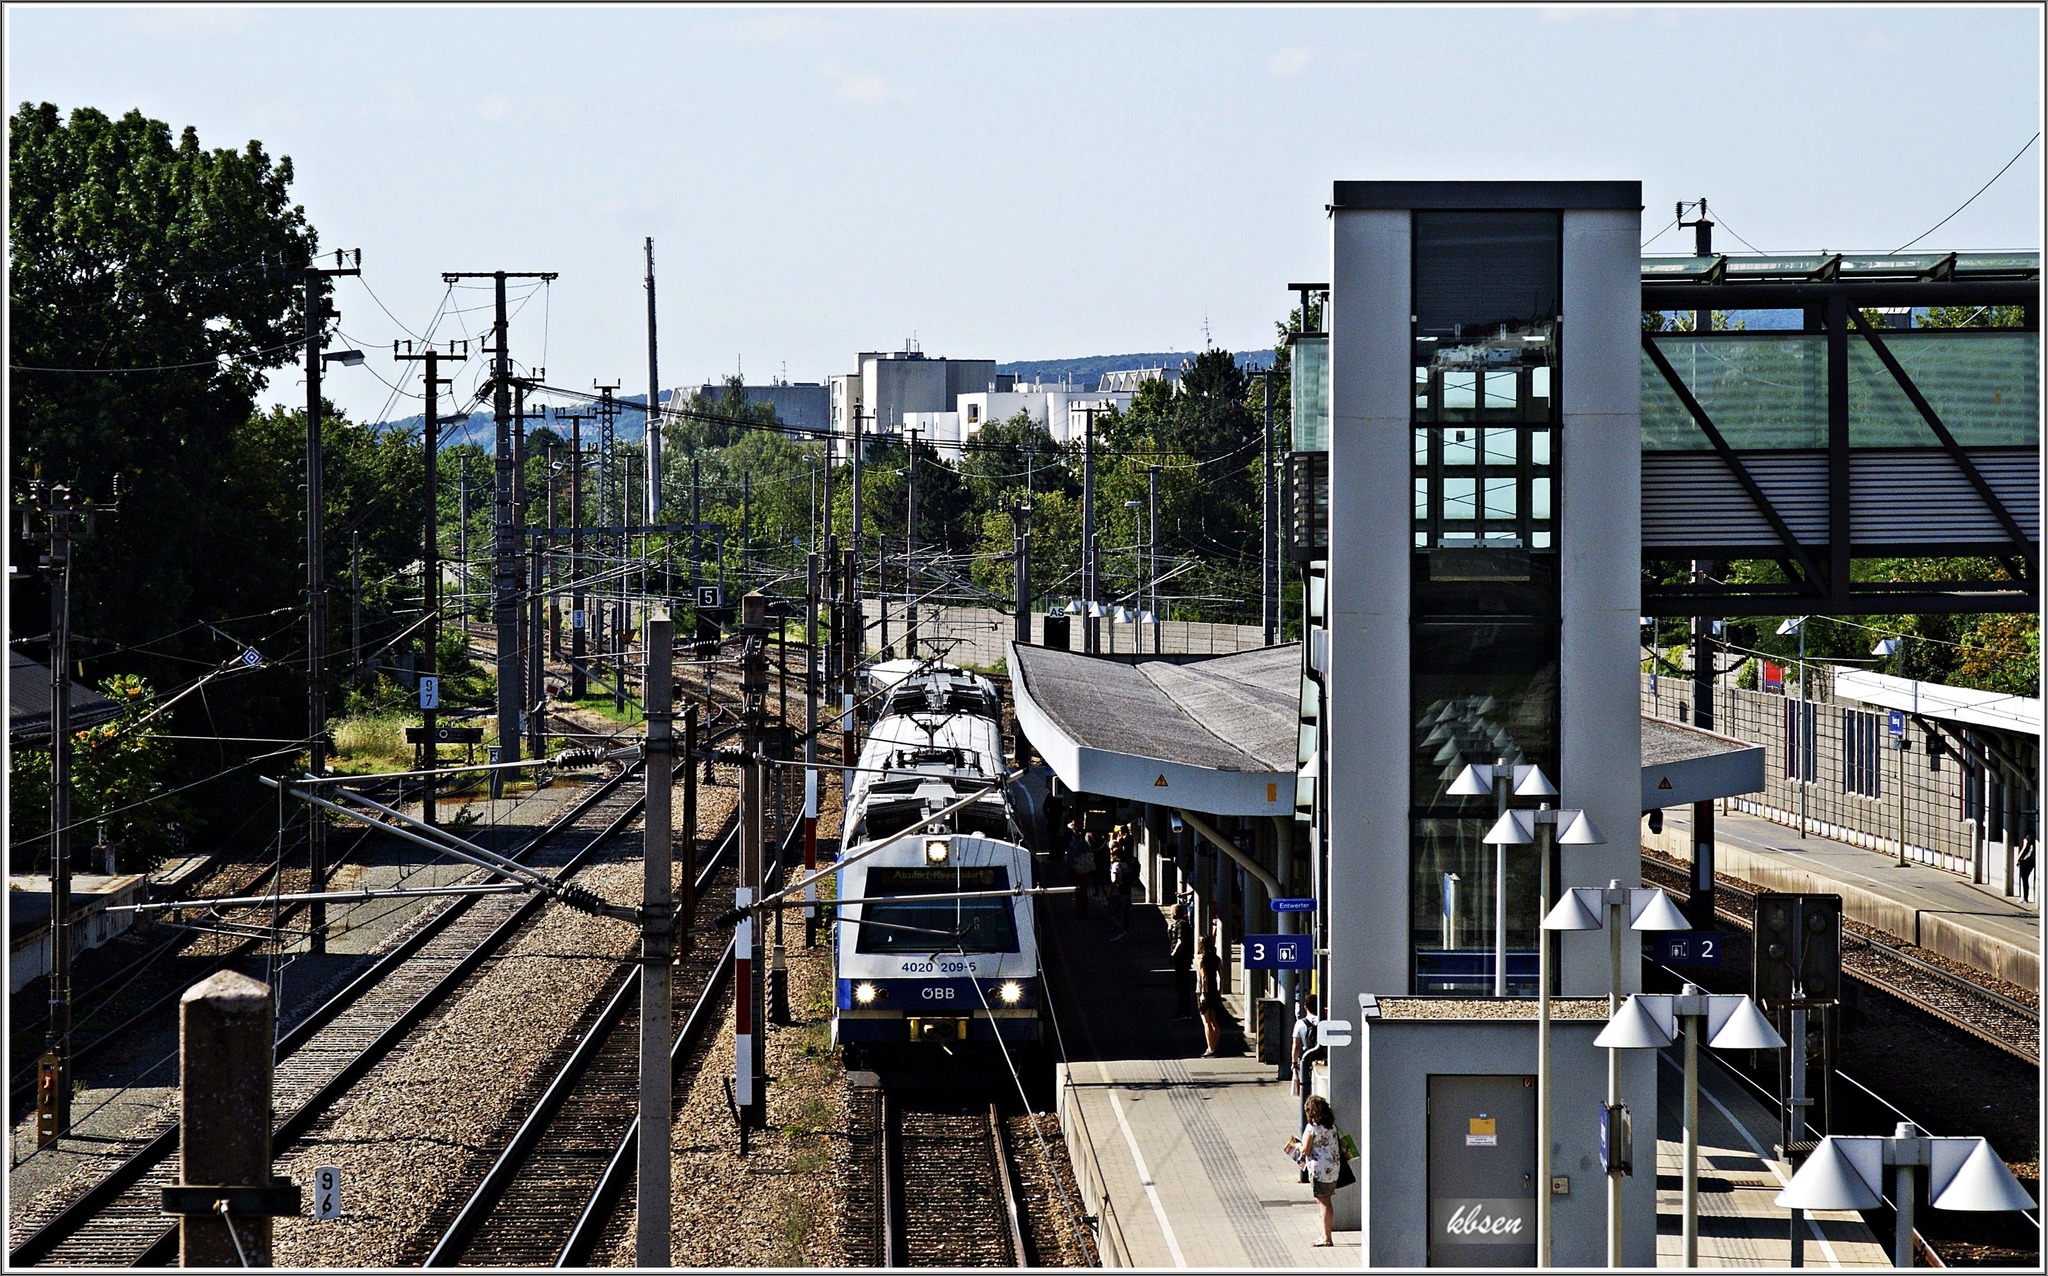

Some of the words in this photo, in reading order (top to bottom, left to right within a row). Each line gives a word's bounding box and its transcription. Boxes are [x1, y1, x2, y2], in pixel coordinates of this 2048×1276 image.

[704, 590, 713, 604] 5
[1050, 607, 1065, 617] AS
[425, 679, 433, 691] 9
[425, 694, 433, 706] 7
[1253, 943, 1265, 961] 3
[1701, 940, 1714, 957] 2
[901, 962, 934, 972] 4020
[940, 962, 977, 972] 209-5
[921, 987, 955, 1000] ÖBB
[321, 1172, 333, 1190] 9
[321, 1193, 333, 1214] 6
